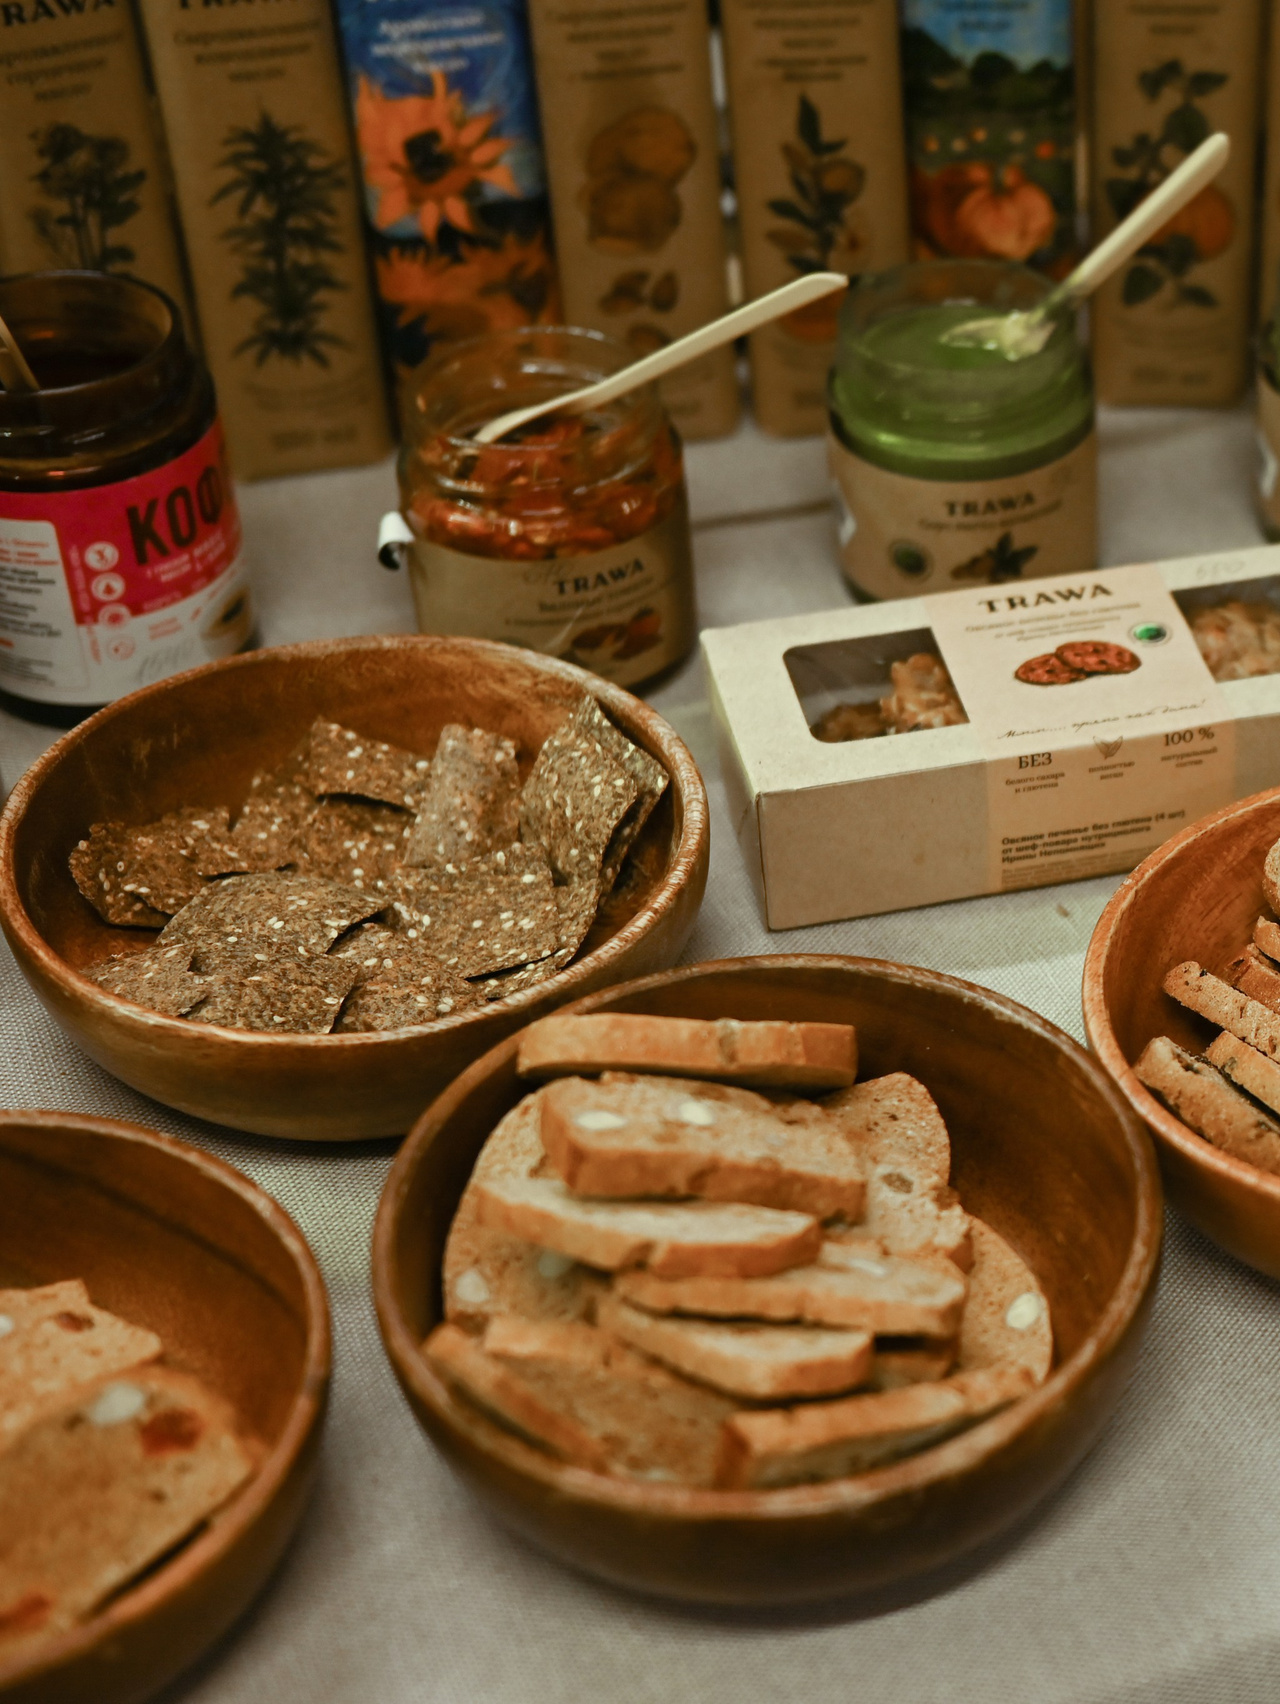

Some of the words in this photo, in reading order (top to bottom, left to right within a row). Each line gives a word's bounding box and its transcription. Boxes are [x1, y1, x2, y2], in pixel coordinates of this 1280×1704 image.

[0, 0, 115, 26] RAW
[945, 492, 1035, 516] TRAWA
[553, 558, 644, 594] TRAWA
[978, 584, 1113, 613] TRAWA
[1164, 730, 1194, 747] 100
[1198, 726, 1215, 740] %
[1018, 752, 1053, 770] БЕЗ
[1005, 775, 1035, 786] белого
[1036, 771, 1065, 782] сахара
[1023, 781, 1059, 793] глютена
[1001, 833, 1045, 846] Овсяное
[1047, 827, 1089, 840] печенье
[1092, 822, 1110, 832] без
[1112, 815, 1153, 828] глютена
[1001, 847, 1013, 855] от
[1015, 837, 1079, 852] шеф-повара
[1001, 852, 1038, 864] Ирины
